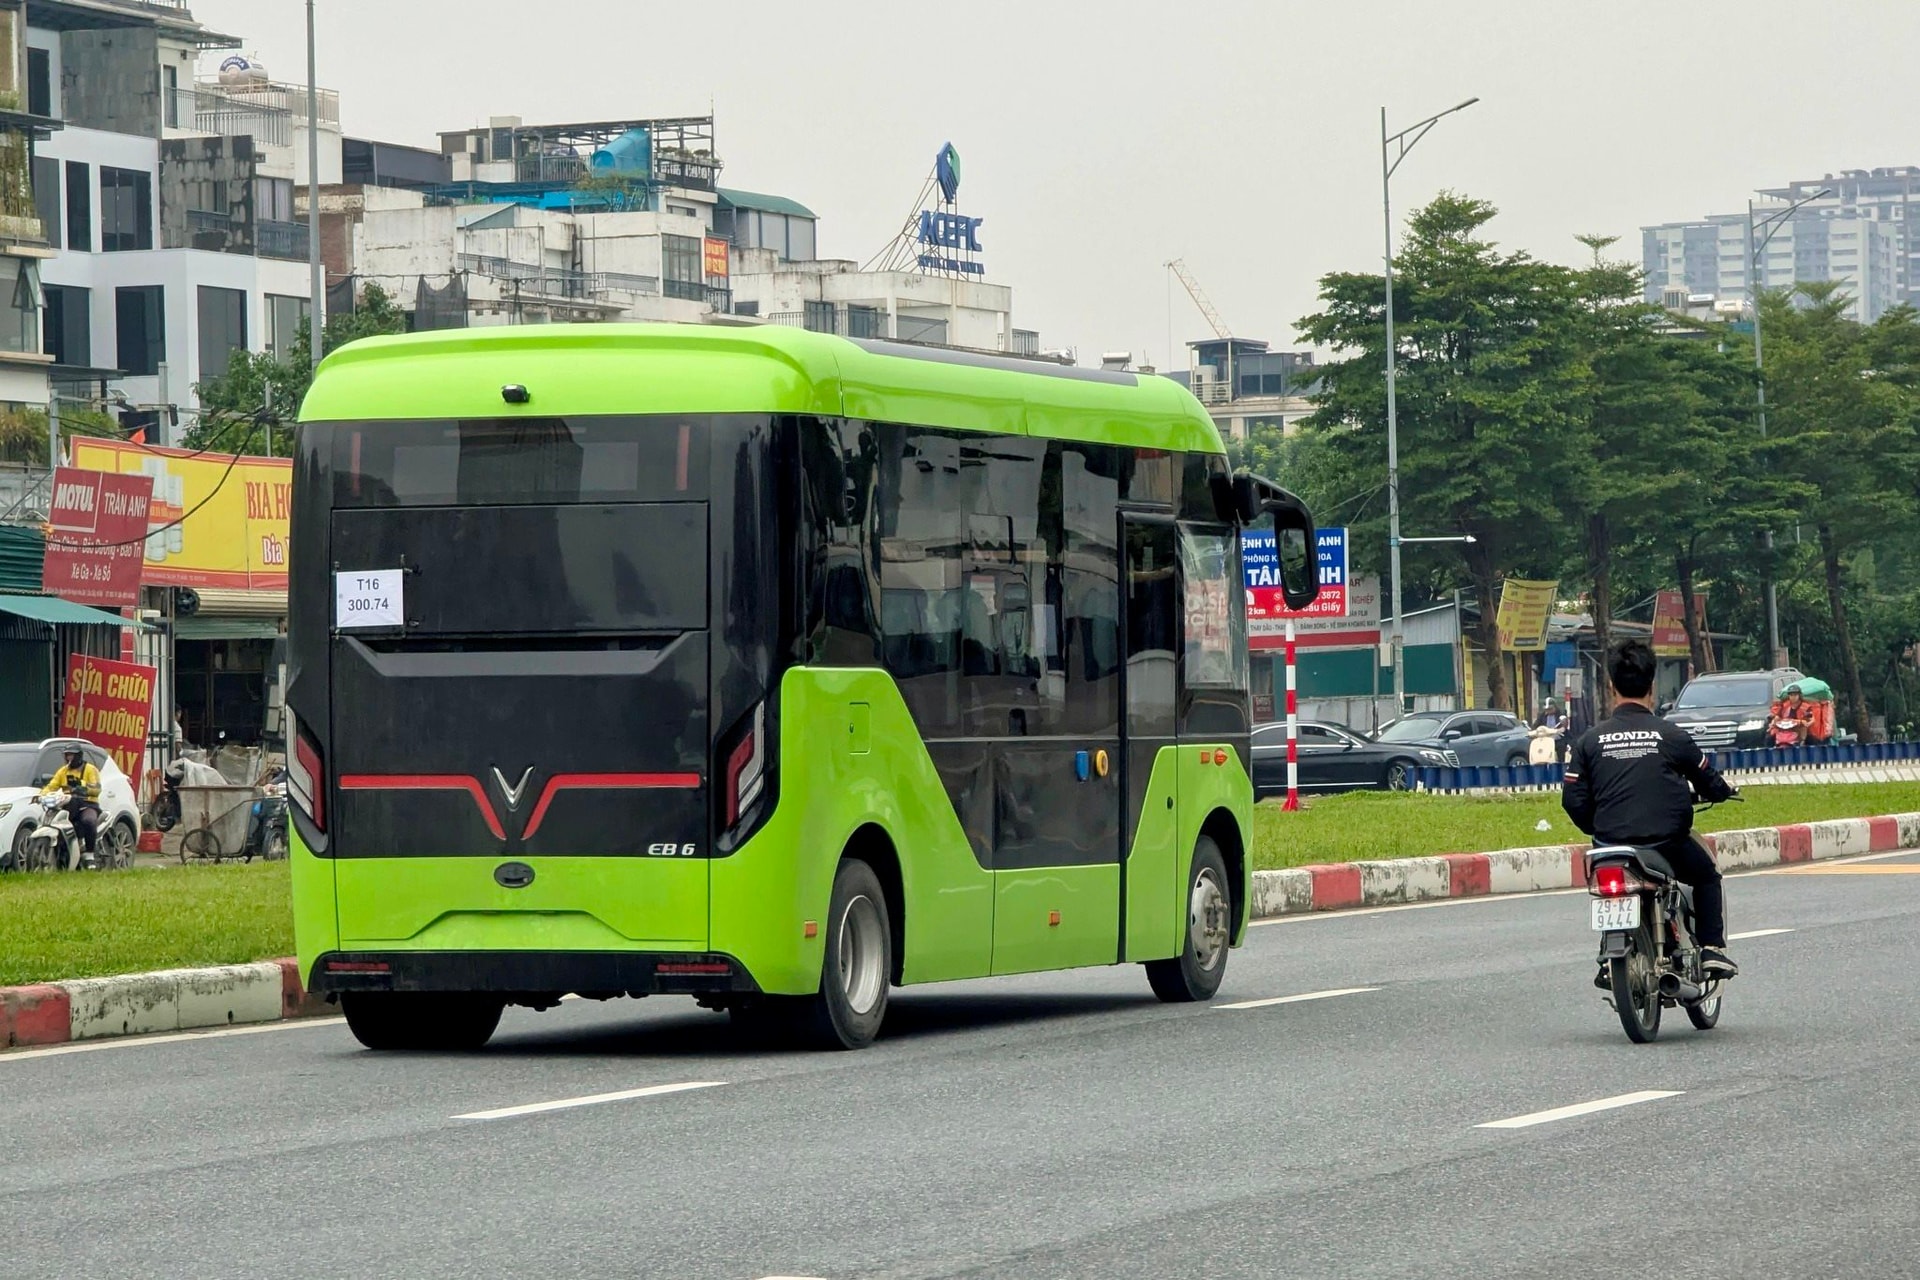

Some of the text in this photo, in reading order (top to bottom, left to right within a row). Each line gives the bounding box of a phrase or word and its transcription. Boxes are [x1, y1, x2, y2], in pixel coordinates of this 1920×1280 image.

[54, 483, 95, 512] MOTUL
[245, 481, 273, 520] BIA
[127, 495, 148, 518] ANH
[262, 533, 285, 565] Bia
[1241, 536, 1341, 551] ỆNH VI ANH
[1318, 553, 1332, 561] OA
[71, 563, 79, 579] Xe
[80, 563, 89, 579] Ga
[93, 563, 102, 580] Xe
[356, 578, 380, 591] T16
[1321, 590, 1341, 599] 3872
[347, 597, 389, 612] 300.74
[1321, 601, 1341, 613] Giấy
[70, 662, 149, 703] SỬA CHỮA
[65, 698, 145, 740] BẢO DƯỠNG
[1598, 730, 1663, 743] HONDA
[105, 745, 139, 776] ÁY
[648, 843, 696, 856] EB 6
[1597, 898, 1633, 913] 29-K2
[1597, 912, 1633, 928] 9444
